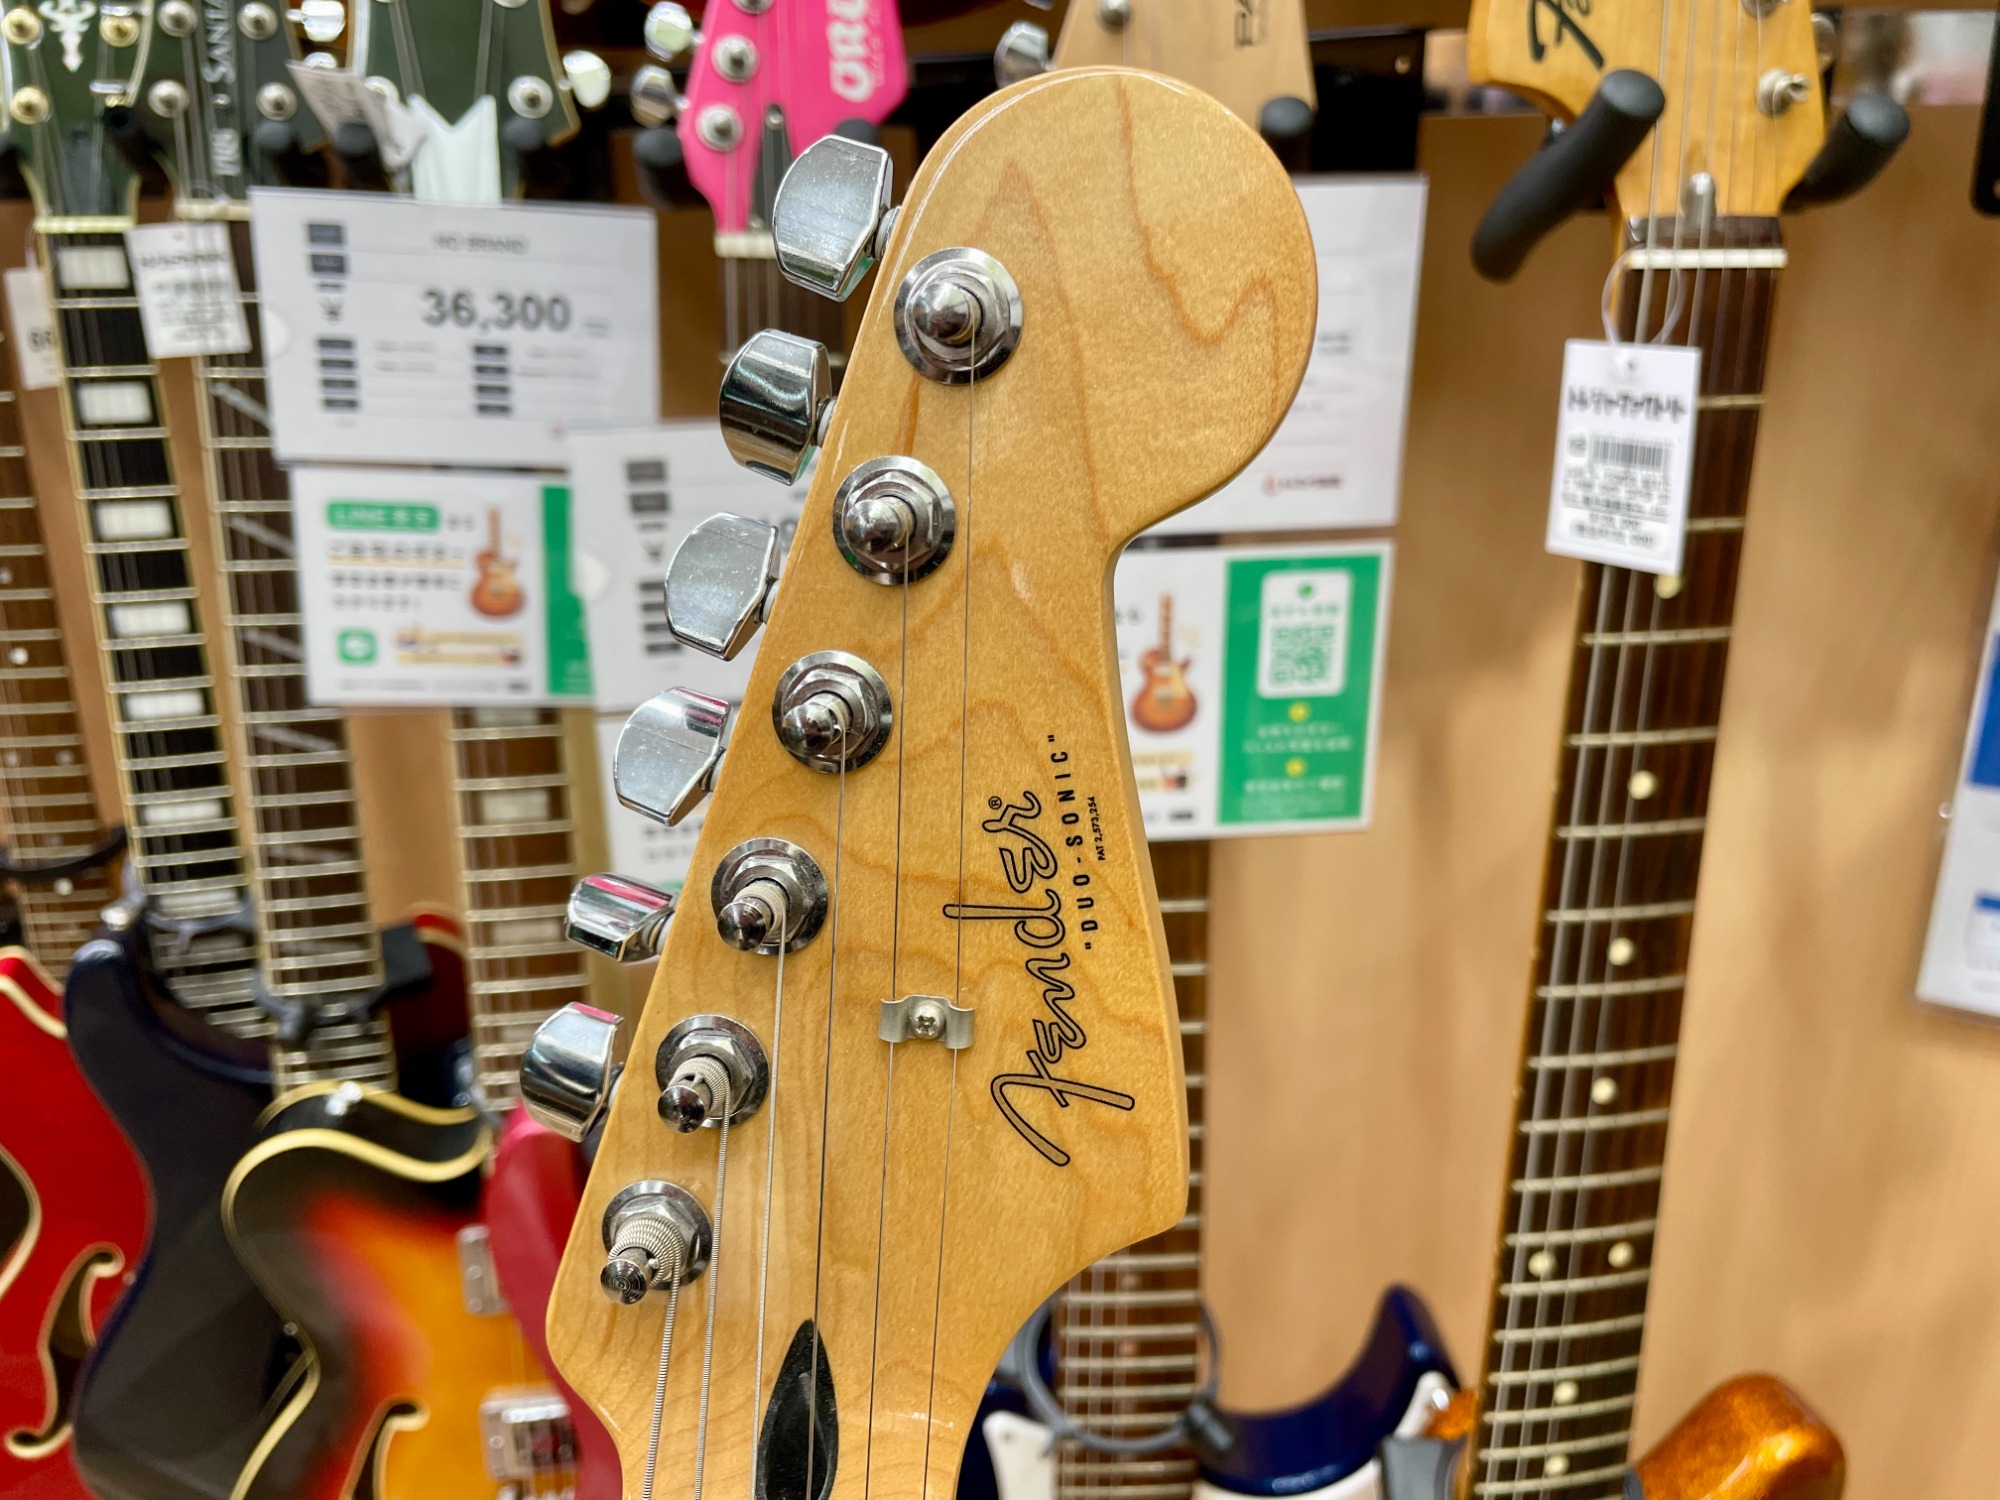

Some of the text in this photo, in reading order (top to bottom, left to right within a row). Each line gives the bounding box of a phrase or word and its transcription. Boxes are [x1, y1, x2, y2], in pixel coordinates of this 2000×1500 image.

[422, 287, 571, 333] 36,300
[1087, 796, 1106, 861] PAT 2,573,254
